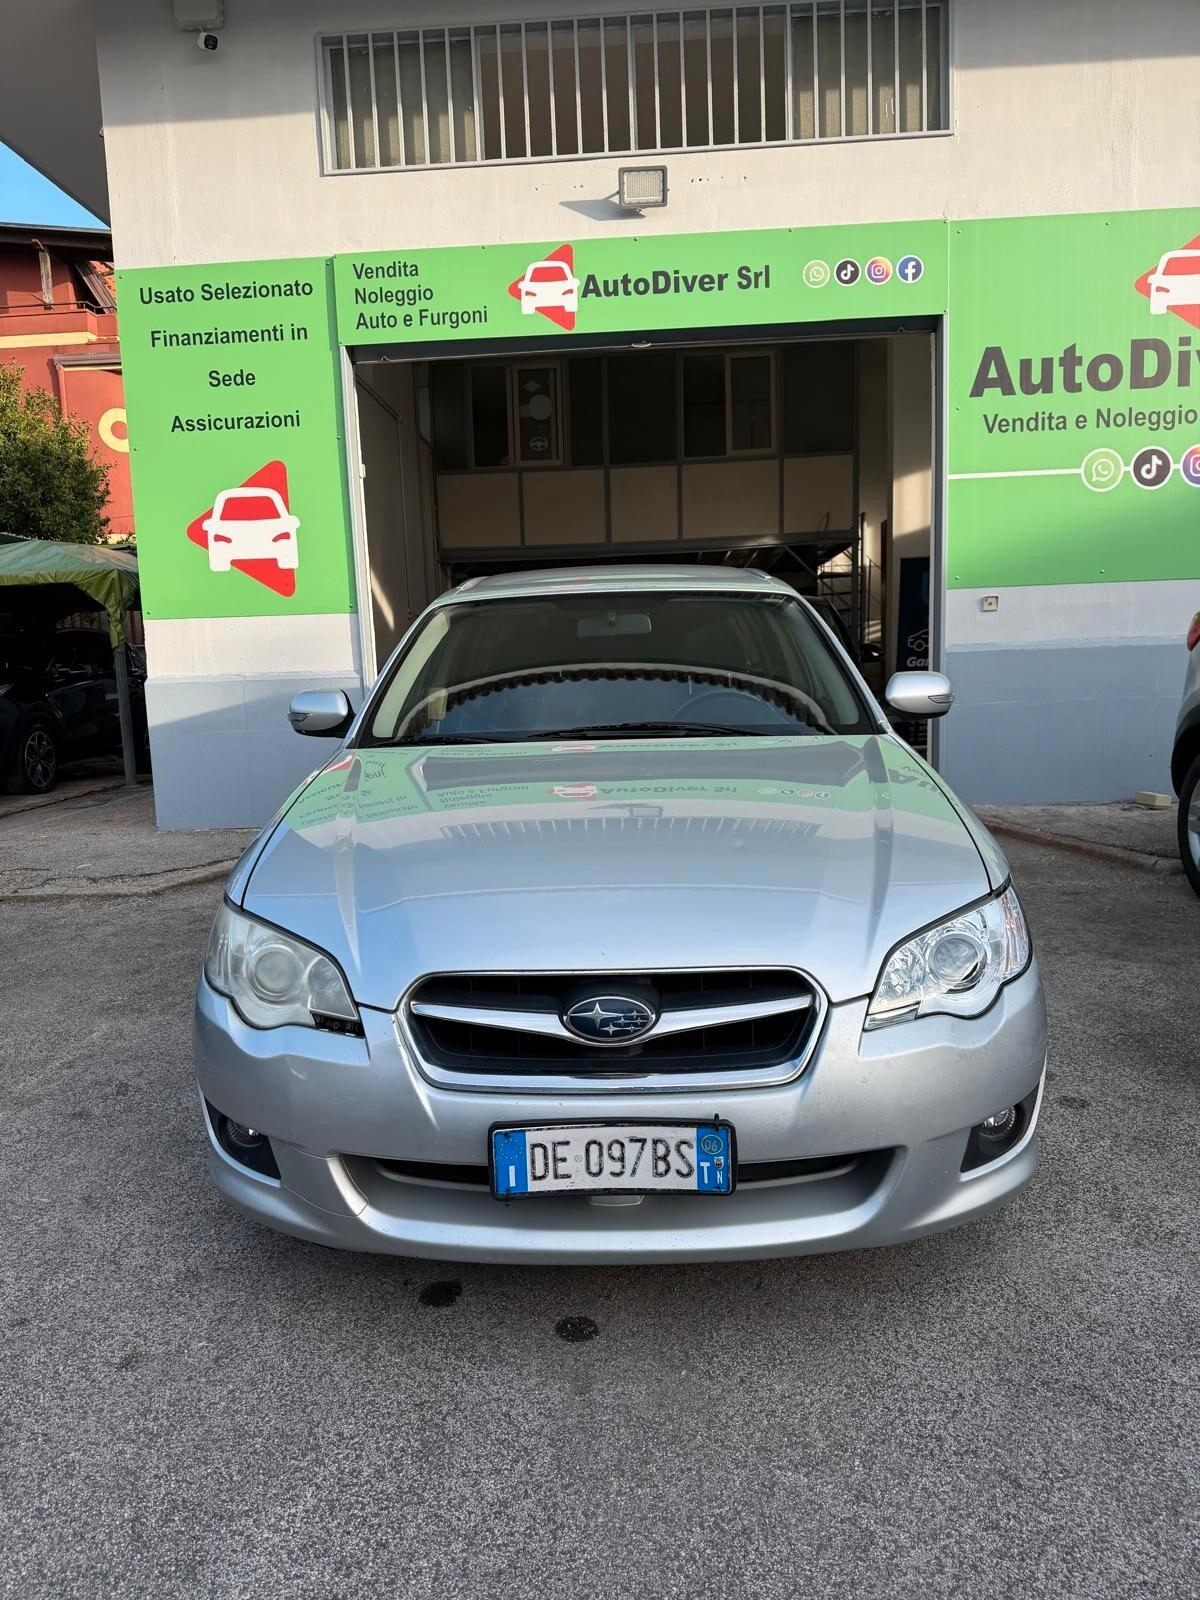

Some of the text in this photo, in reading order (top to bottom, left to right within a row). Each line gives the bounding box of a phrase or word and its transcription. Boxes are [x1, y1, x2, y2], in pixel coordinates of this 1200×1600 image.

[352, 261, 419, 280] Vendita
[581, 264, 771, 298] AutoDiver Srl
[139, 280, 313, 304] Usato Selezionato
[354, 284, 434, 307] Noleggio
[355, 306, 488, 330] Auto e Furgoni
[150, 323, 308, 347] Finanziamenti in
[208, 369, 256, 387] Sede
[968, 336, 1200, 398] AutoDi
[170, 410, 301, 432] Assicurazioni
[982, 404, 1198, 434] Vendita e Noleggio
[529, 1139, 572, 1181] DE
[584, 1136, 695, 1180] 097BS
